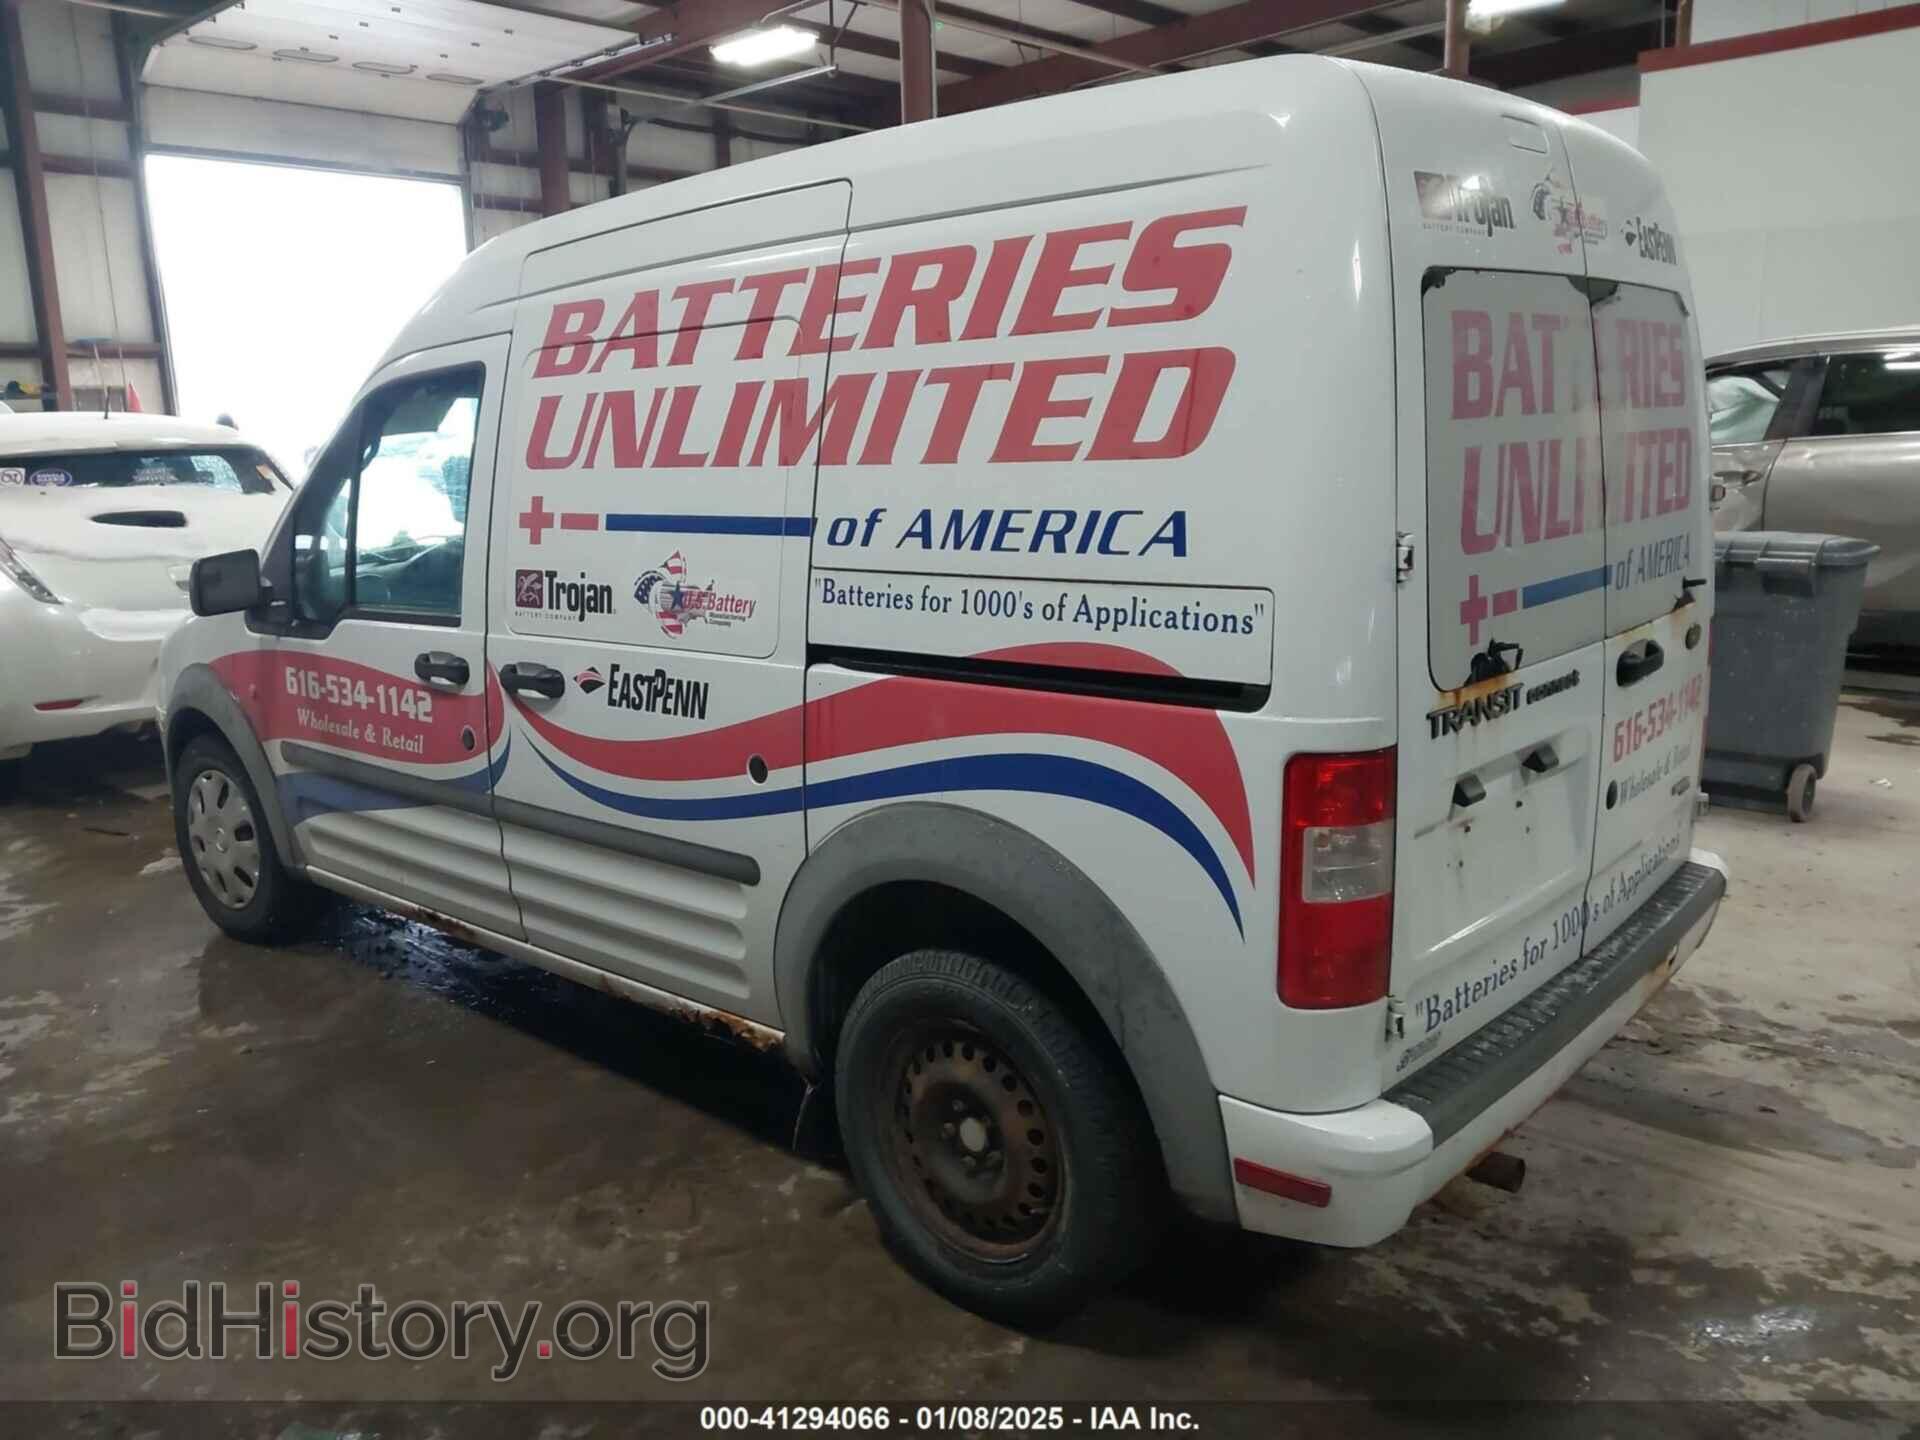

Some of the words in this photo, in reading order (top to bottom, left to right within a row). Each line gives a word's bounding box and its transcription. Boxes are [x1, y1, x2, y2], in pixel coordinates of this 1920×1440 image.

[532, 206, 1246, 379] BATTERIES
[1449, 310, 1685, 421] BATRIES
[526, 346, 1236, 470] UNLIMITED
[1460, 428, 1691, 555] UNLIITED
[827, 509, 887, 547] of
[896, 509, 1187, 557] AMERICA
[545, 570, 613, 622] Trojan
[707, 593, 757, 619] Battery
[920, 585, 952, 615] for
[961, 589, 1033, 620] 1000's
[1042, 594, 1067, 623] of
[284, 666, 433, 724] 616-534-1142
[1426, 683, 1525, 740] TRANSIT
[296, 707, 360, 739] Wholesale
[363, 724, 377, 743] &
[383, 727, 424, 754] Retail
[1523, 936, 1548, 972] for
[1602, 877, 1616, 915] of
